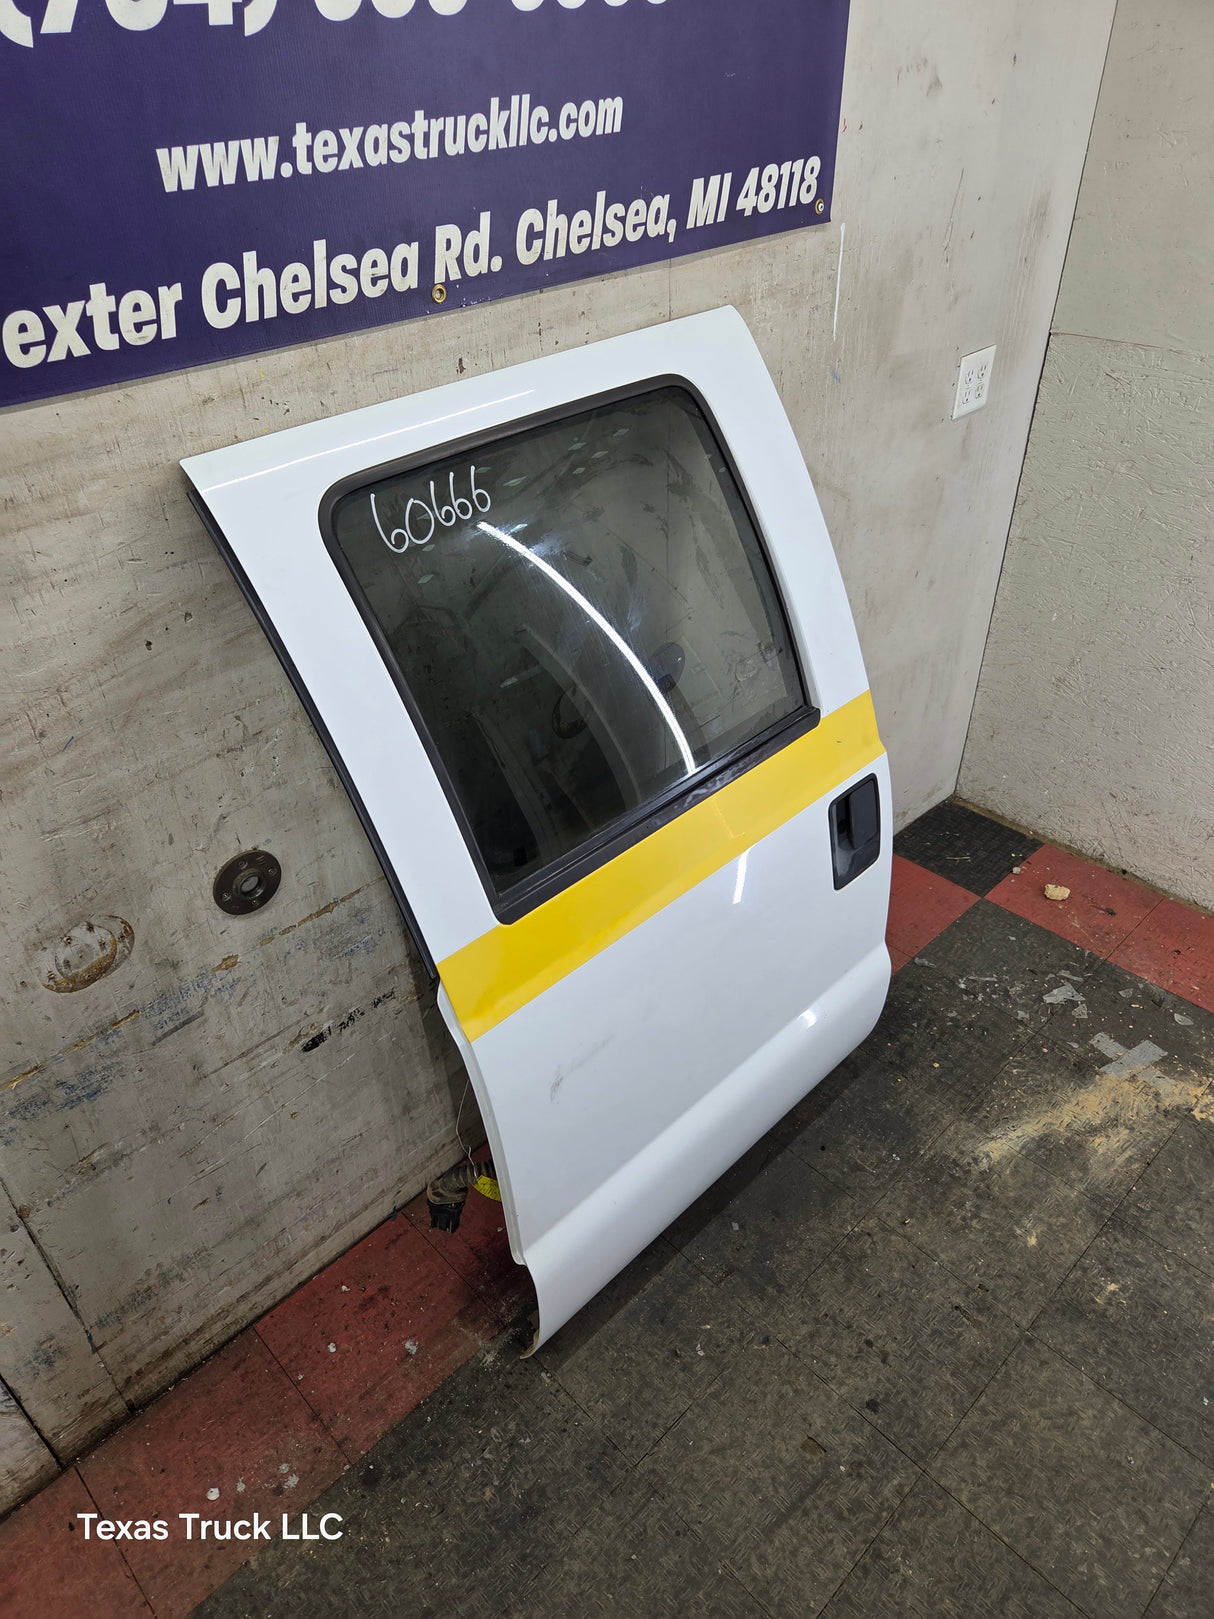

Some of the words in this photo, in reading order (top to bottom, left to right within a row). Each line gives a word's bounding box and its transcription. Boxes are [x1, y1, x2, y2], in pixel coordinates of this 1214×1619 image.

[156, 94, 624, 193] www.texastruckllc.com
[3, 282, 183, 369] exter
[201, 239, 419, 329] Chelsea
[434, 210, 503, 285] Rd.
[515, 191, 677, 265] Chelsea,
[686, 172, 733, 230] MI
[735, 155, 821, 217] 48118
[370, 465, 491, 553] 60666
